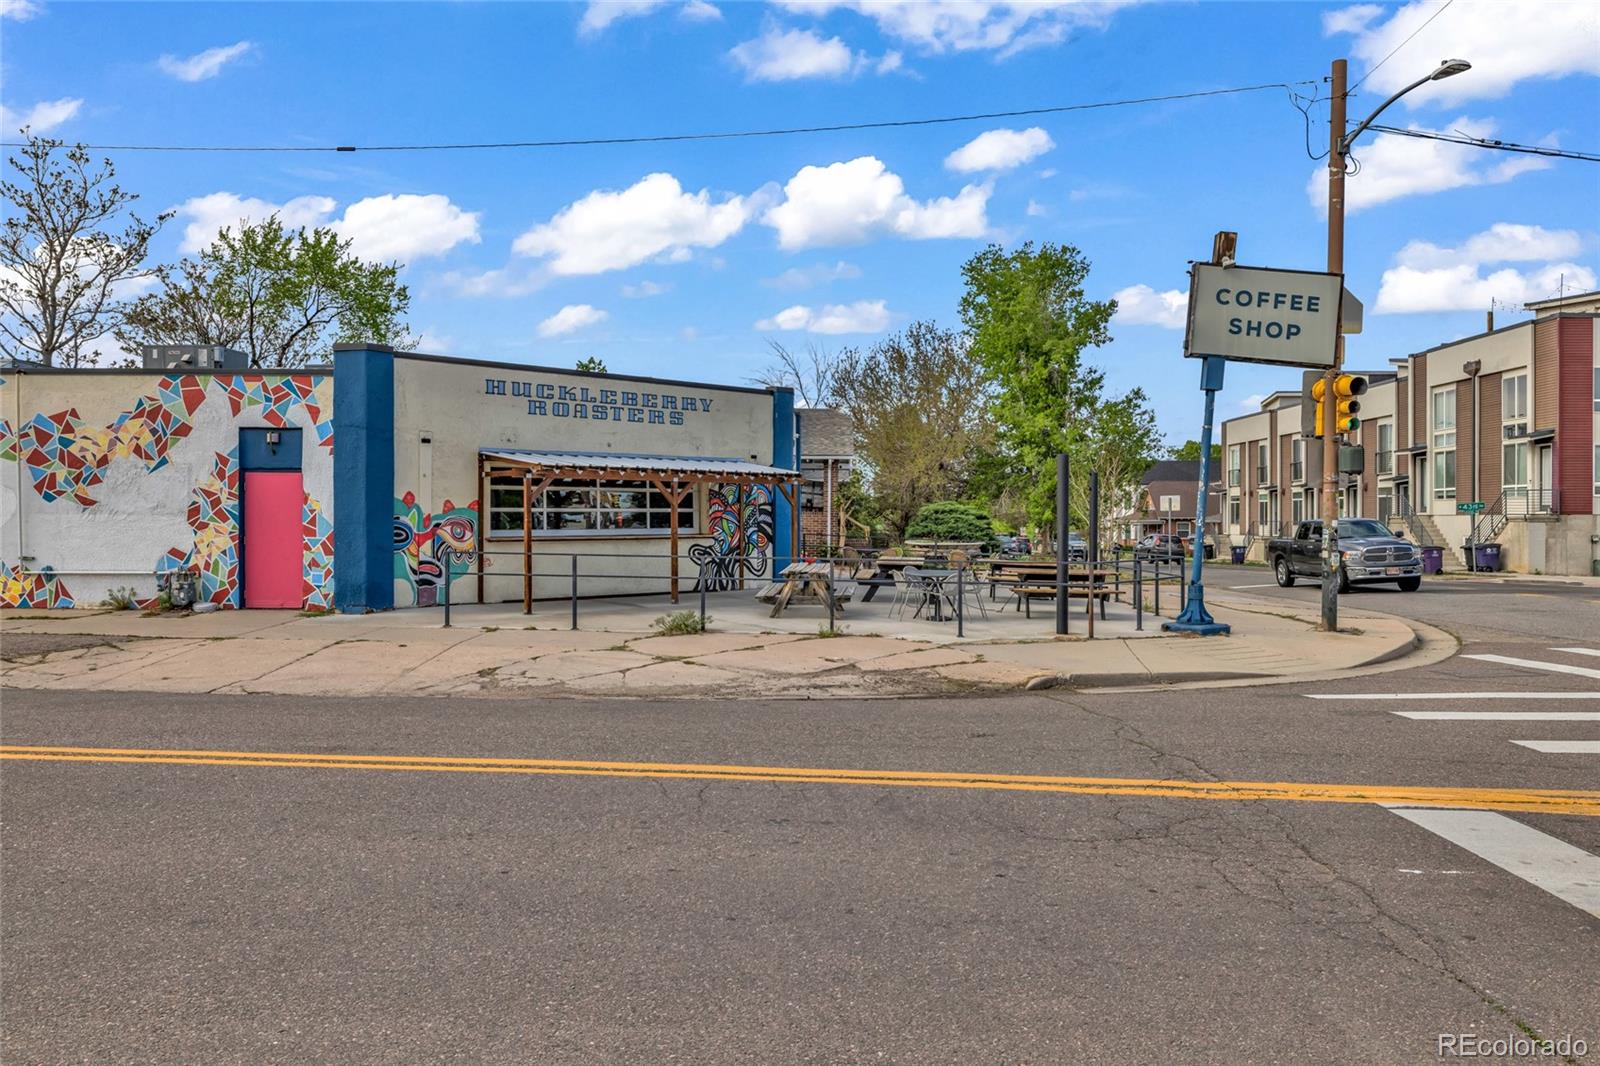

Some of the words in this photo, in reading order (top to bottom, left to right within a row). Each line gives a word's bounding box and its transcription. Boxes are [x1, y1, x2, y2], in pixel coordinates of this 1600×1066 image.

[1215, 288, 1321, 313] COFFEE
[1228, 317, 1302, 340] SHOP
[485, 378, 714, 413] HUCKLEBERRY
[527, 399, 685, 426] ROASTERS
